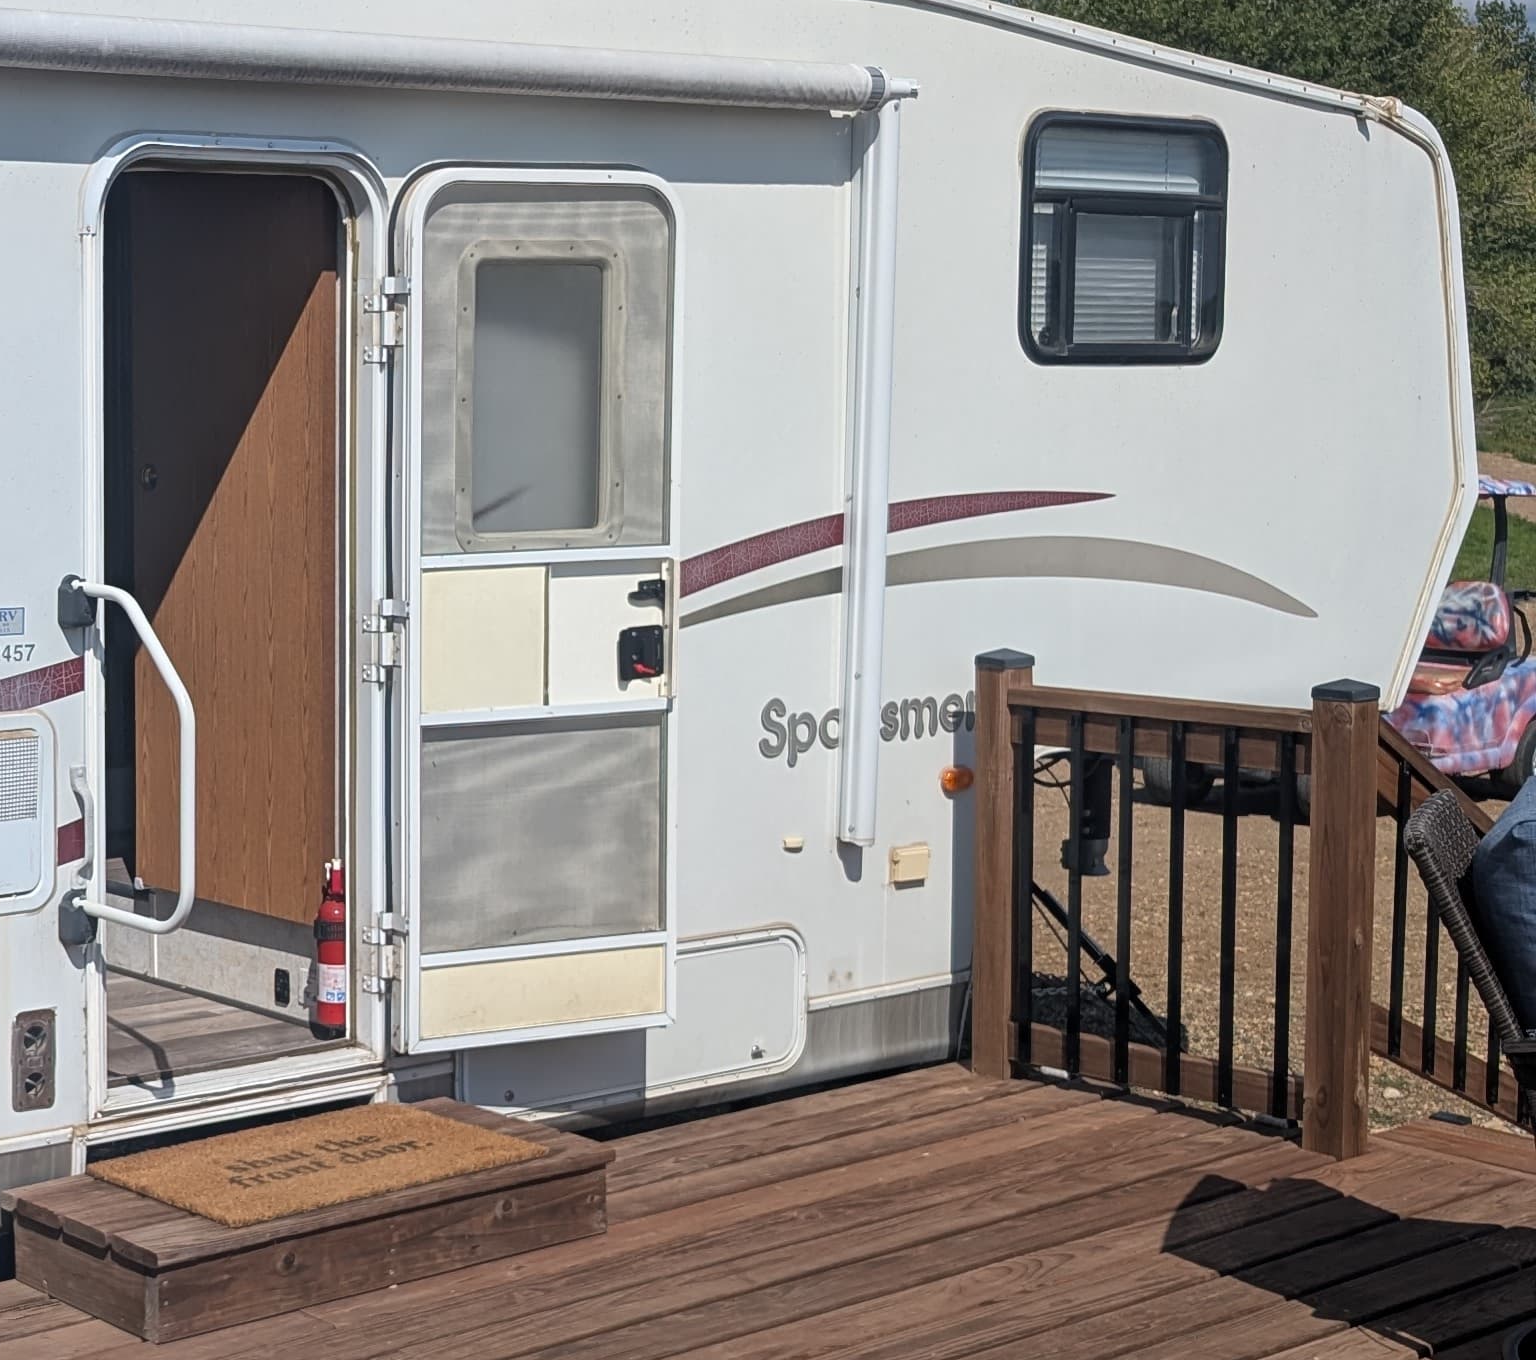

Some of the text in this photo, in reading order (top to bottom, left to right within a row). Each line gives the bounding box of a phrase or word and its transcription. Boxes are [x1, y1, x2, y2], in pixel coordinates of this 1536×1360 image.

[758, 690, 975, 768] Sposme
[224, 1135, 381, 1173] shut the
[228, 1160, 337, 1189] front
